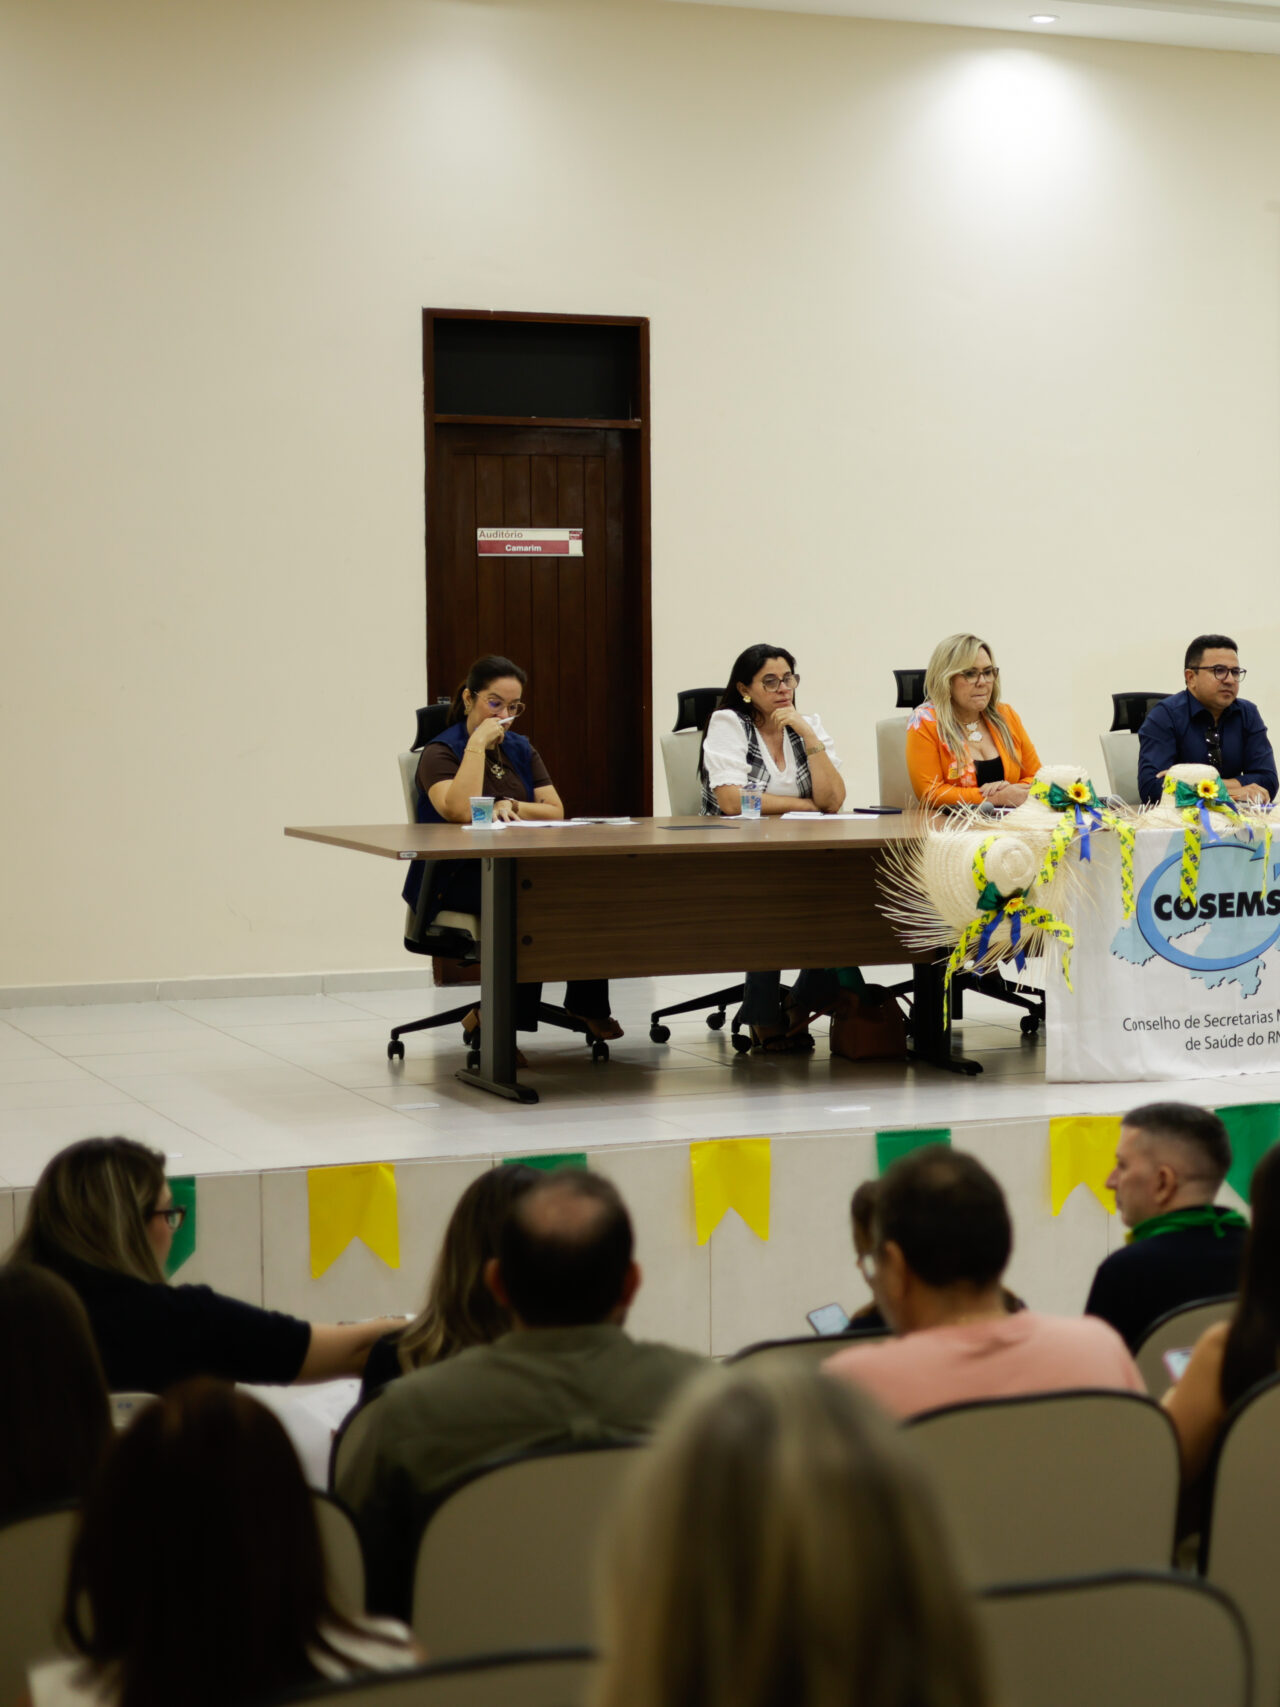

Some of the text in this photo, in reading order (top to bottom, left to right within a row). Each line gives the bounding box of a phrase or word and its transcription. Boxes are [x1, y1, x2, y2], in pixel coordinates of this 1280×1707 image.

[479, 530, 523, 539] Auditório
[505, 544, 542, 552] Camarim
[1122, 1016, 1180, 1032] Conselho
[1184, 1015, 1200, 1029] de
[1203, 1011, 1273, 1028] Secretarias
[1185, 1037, 1200, 1051] de
[1204, 1034, 1244, 1050] Saúde
[1247, 1032, 1264, 1046] do
